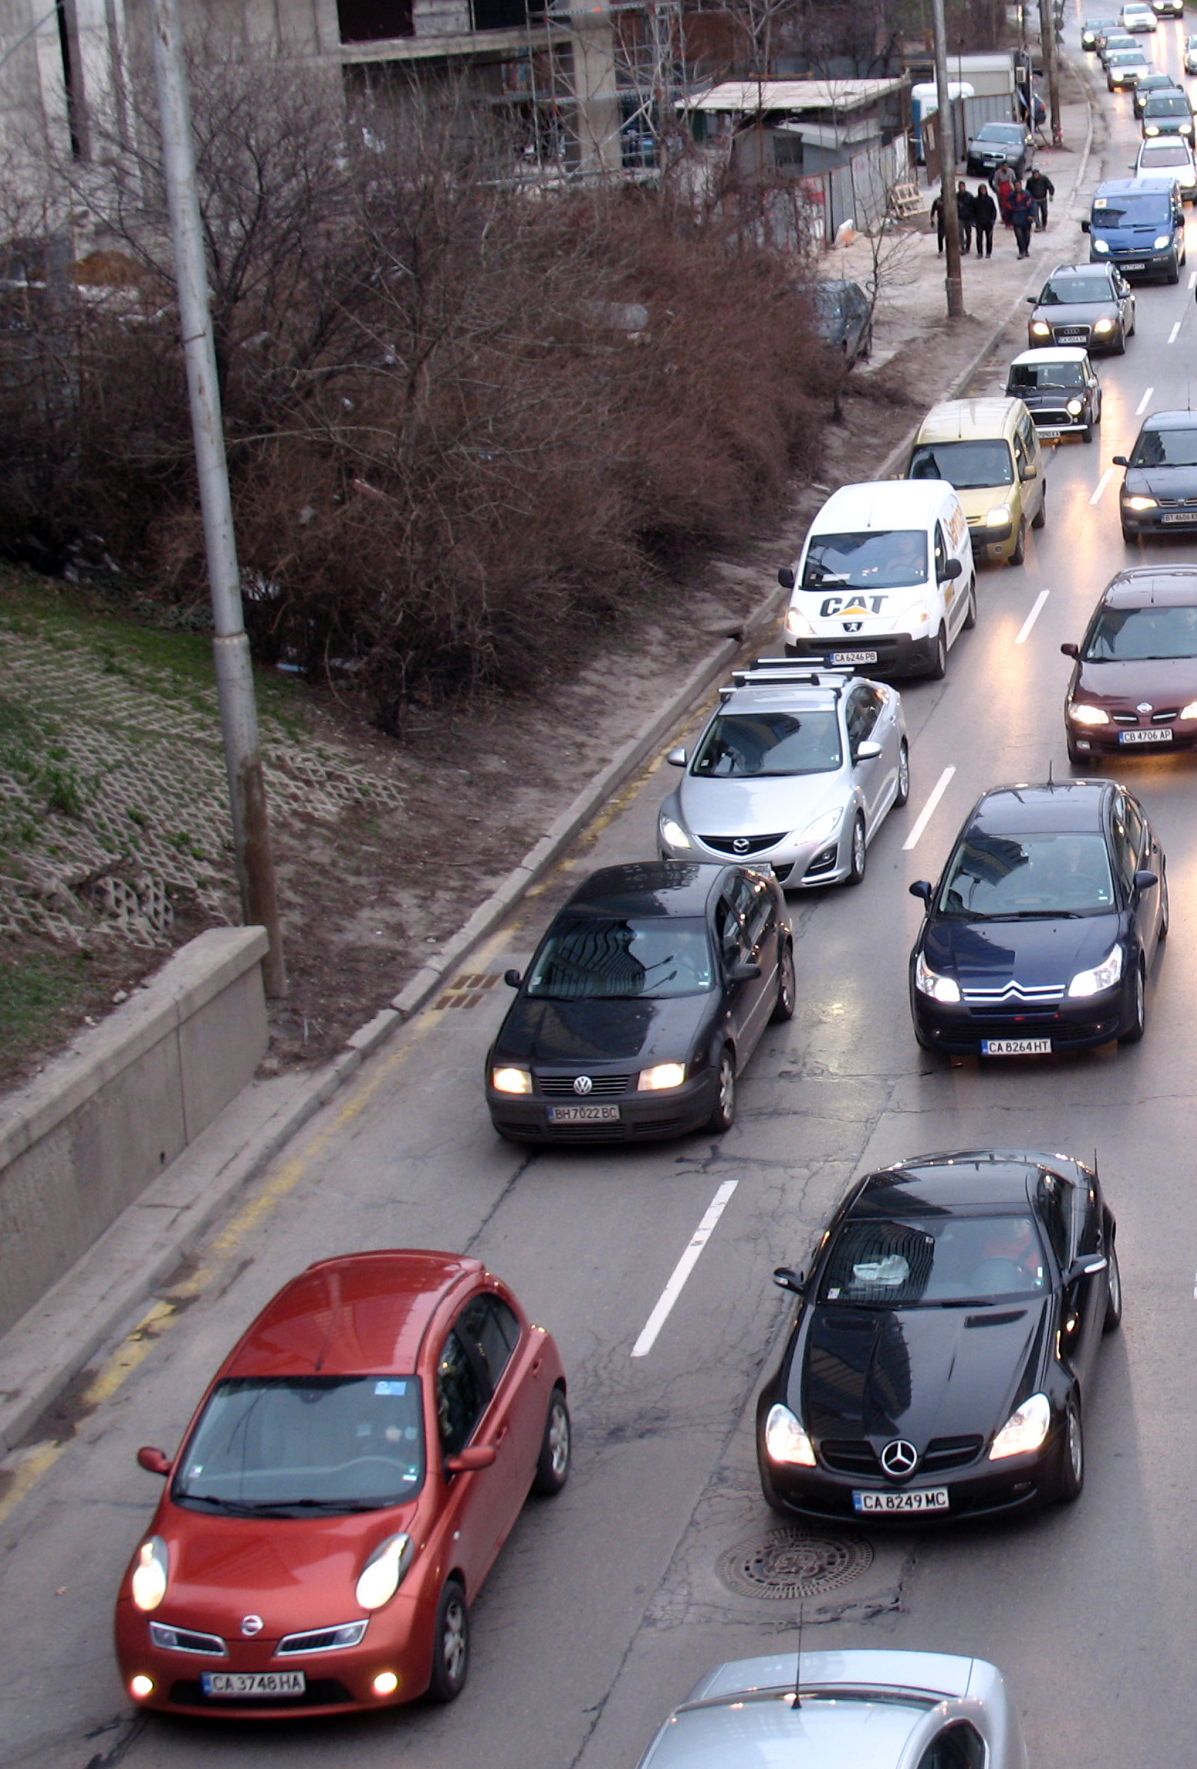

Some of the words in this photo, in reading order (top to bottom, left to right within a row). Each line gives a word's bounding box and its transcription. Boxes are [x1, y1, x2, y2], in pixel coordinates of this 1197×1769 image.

[819, 595, 889, 617] CAT
[835, 654, 845, 662] CA
[1124, 732, 1136, 742] CB
[1137, 731, 1157, 741] 4706
[1160, 730, 1171, 740] AP
[989, 1042, 1004, 1053] CA
[1005, 1041, 1033, 1053] 8264
[1034, 1040, 1048, 1052] HT
[555, 1107, 571, 1120] BH
[571, 1106, 600, 1119] 7022
[601, 1106, 617, 1119] BC
[863, 1495, 883, 1509] CA
[886, 1494, 922, 1510] 8249
[925, 1491, 946, 1507] MC
[212, 1676, 234, 1691] CA
[280, 1674, 302, 1690] HA
